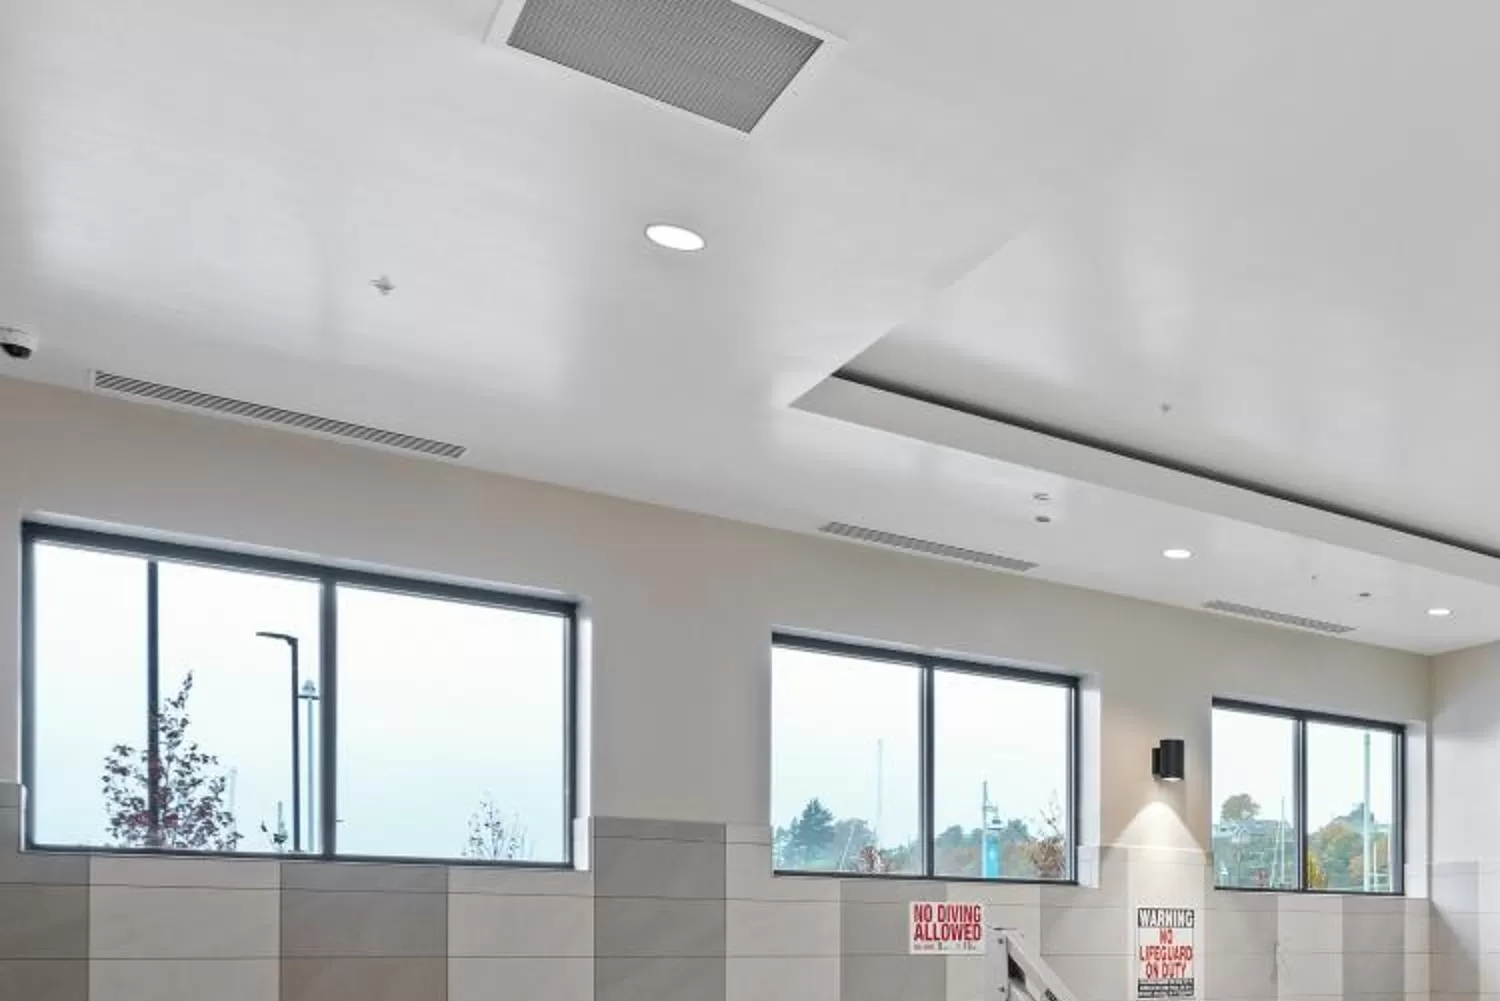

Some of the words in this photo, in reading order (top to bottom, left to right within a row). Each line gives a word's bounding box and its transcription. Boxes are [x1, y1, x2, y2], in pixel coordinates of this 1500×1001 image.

[914, 904, 933, 922] NO
[938, 904, 981, 922] DIVING
[1140, 909, 1193, 927] WARNING
[914, 923, 982, 941] ALLOWED
[1160, 929, 1173, 944] NO
[1140, 945, 1193, 960] LIFEGUARD
[1146, 961, 1159, 978] ON
[1162, 961, 1187, 978] DUTY
